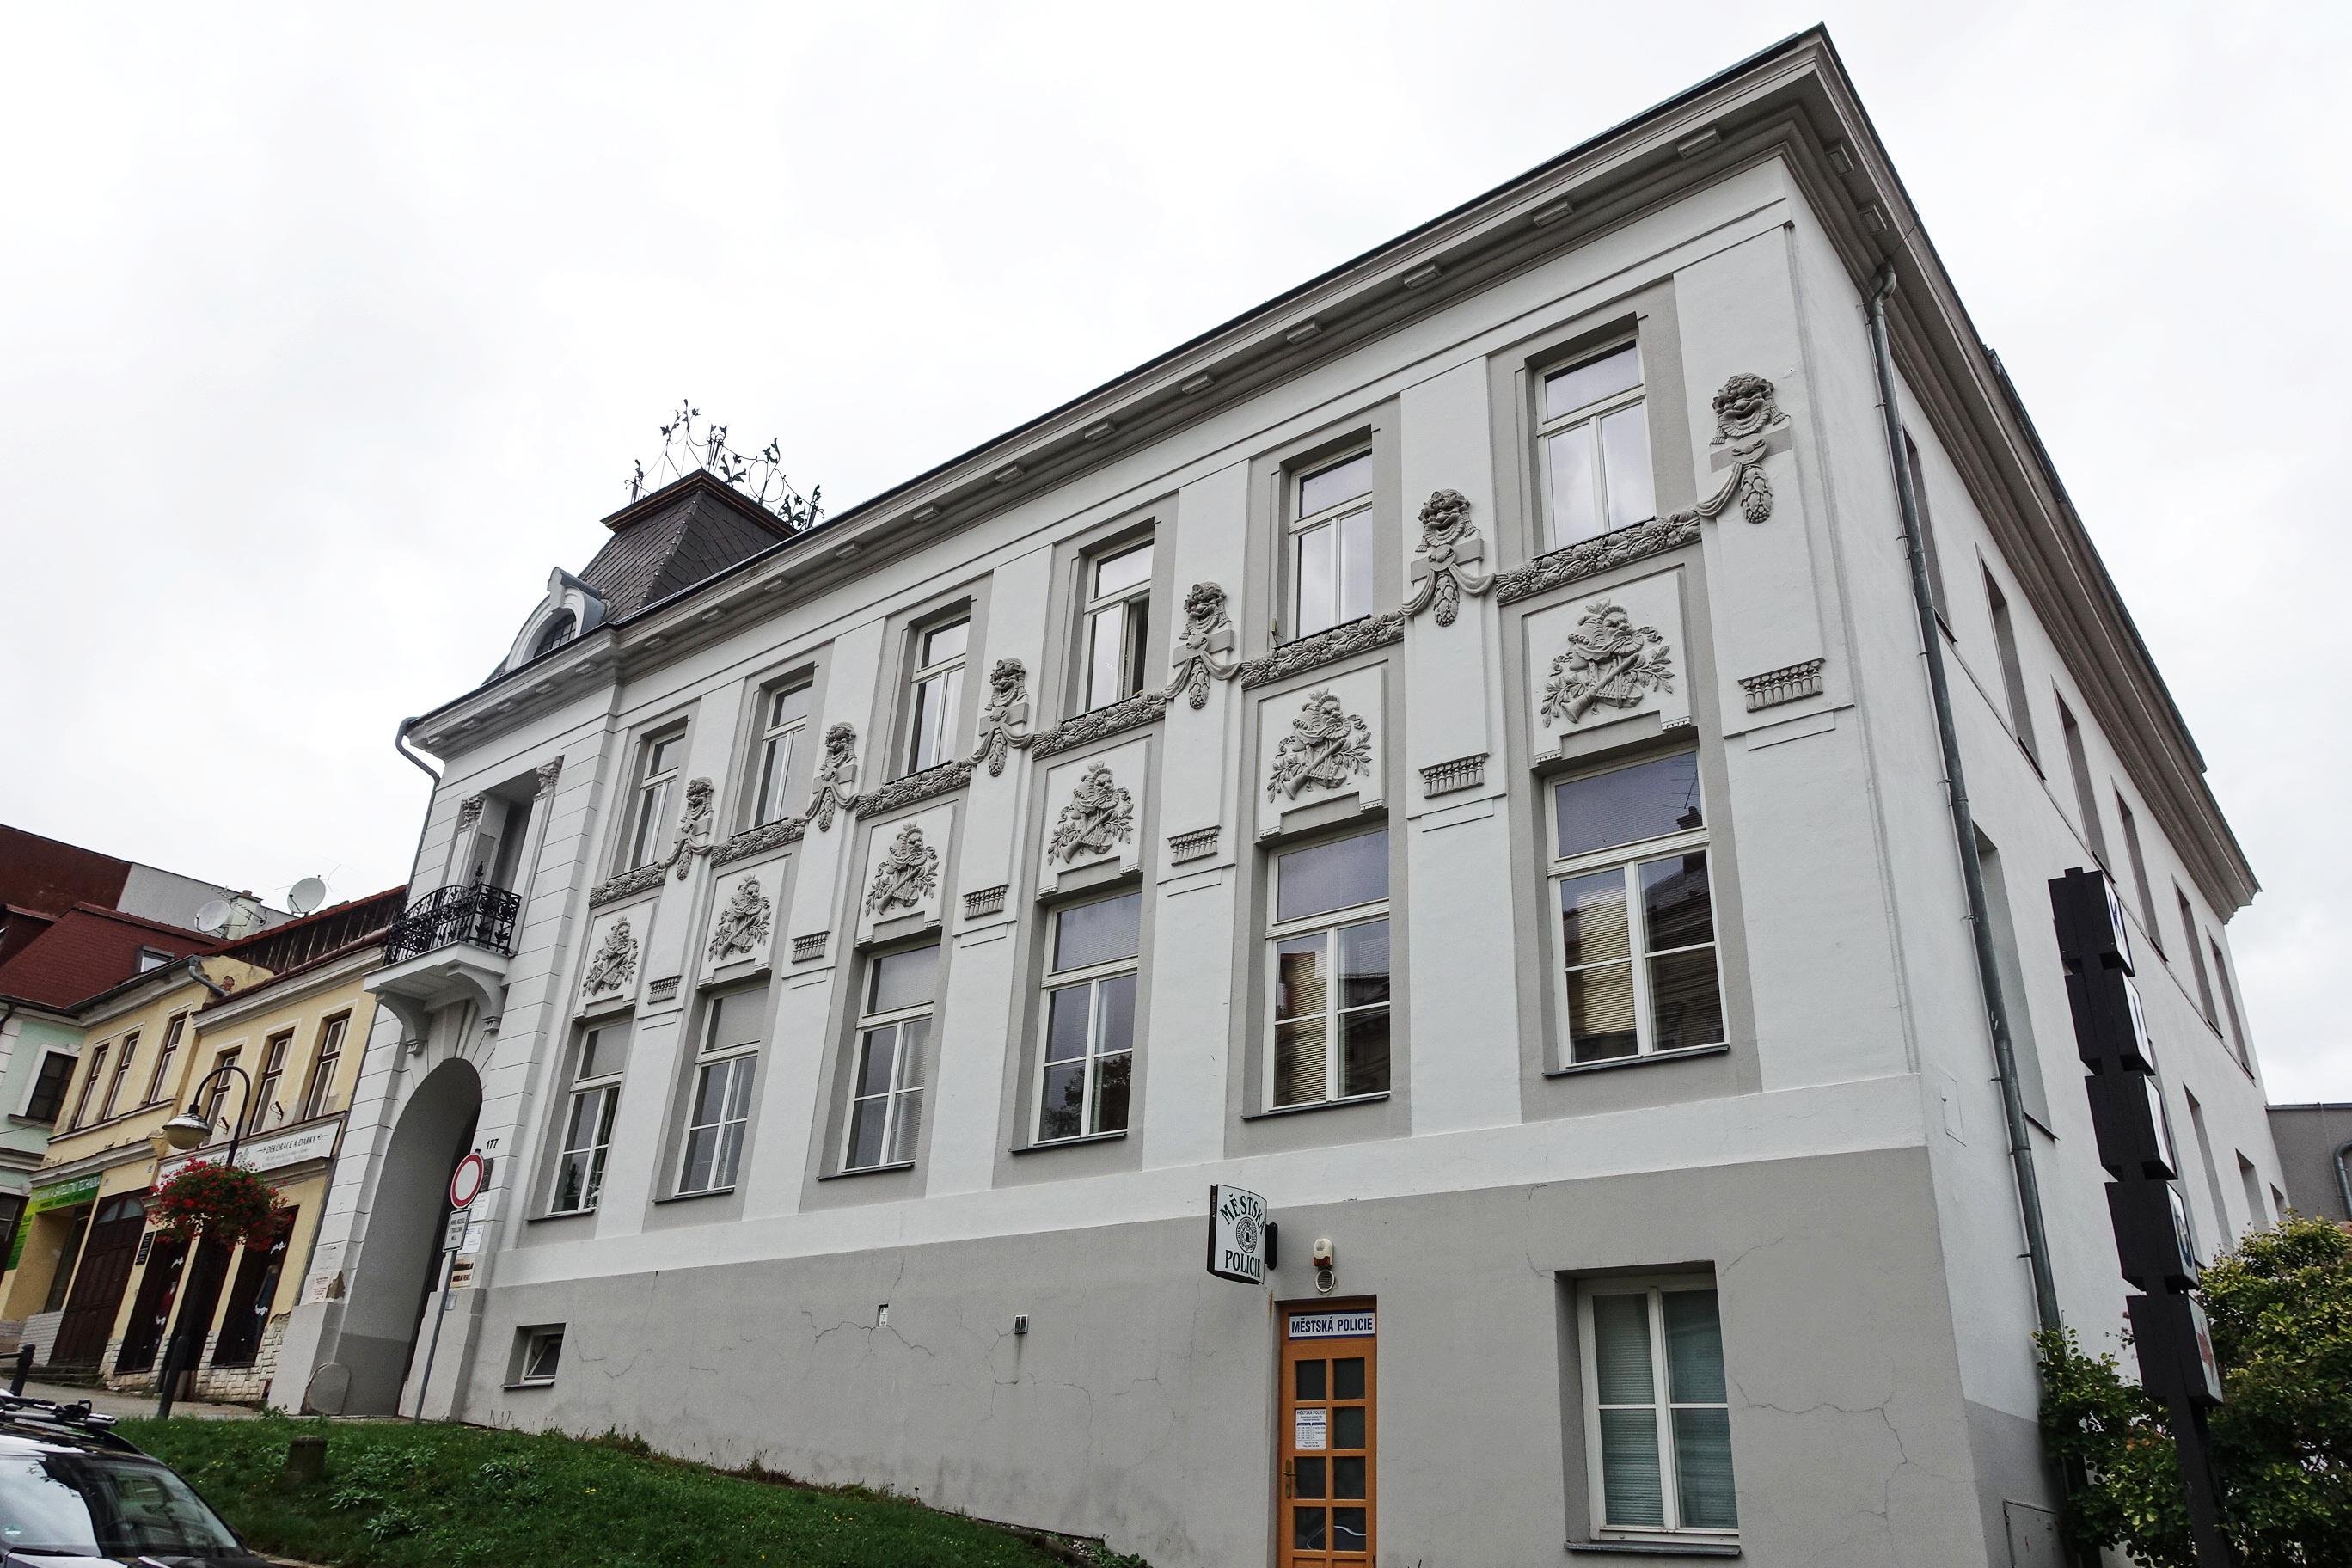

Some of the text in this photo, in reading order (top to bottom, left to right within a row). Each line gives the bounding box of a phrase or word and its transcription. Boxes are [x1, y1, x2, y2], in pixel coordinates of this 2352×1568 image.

[266, 1140, 293, 1154] DEKORACE
[486, 1138, 499, 1150] 177
[1219, 1193, 1266, 1236] MĚSTSKÁ
[1225, 1249, 1261, 1278] POLICIE
[1291, 1316, 1373, 1333] MĚSTSKÁ POLICIE
